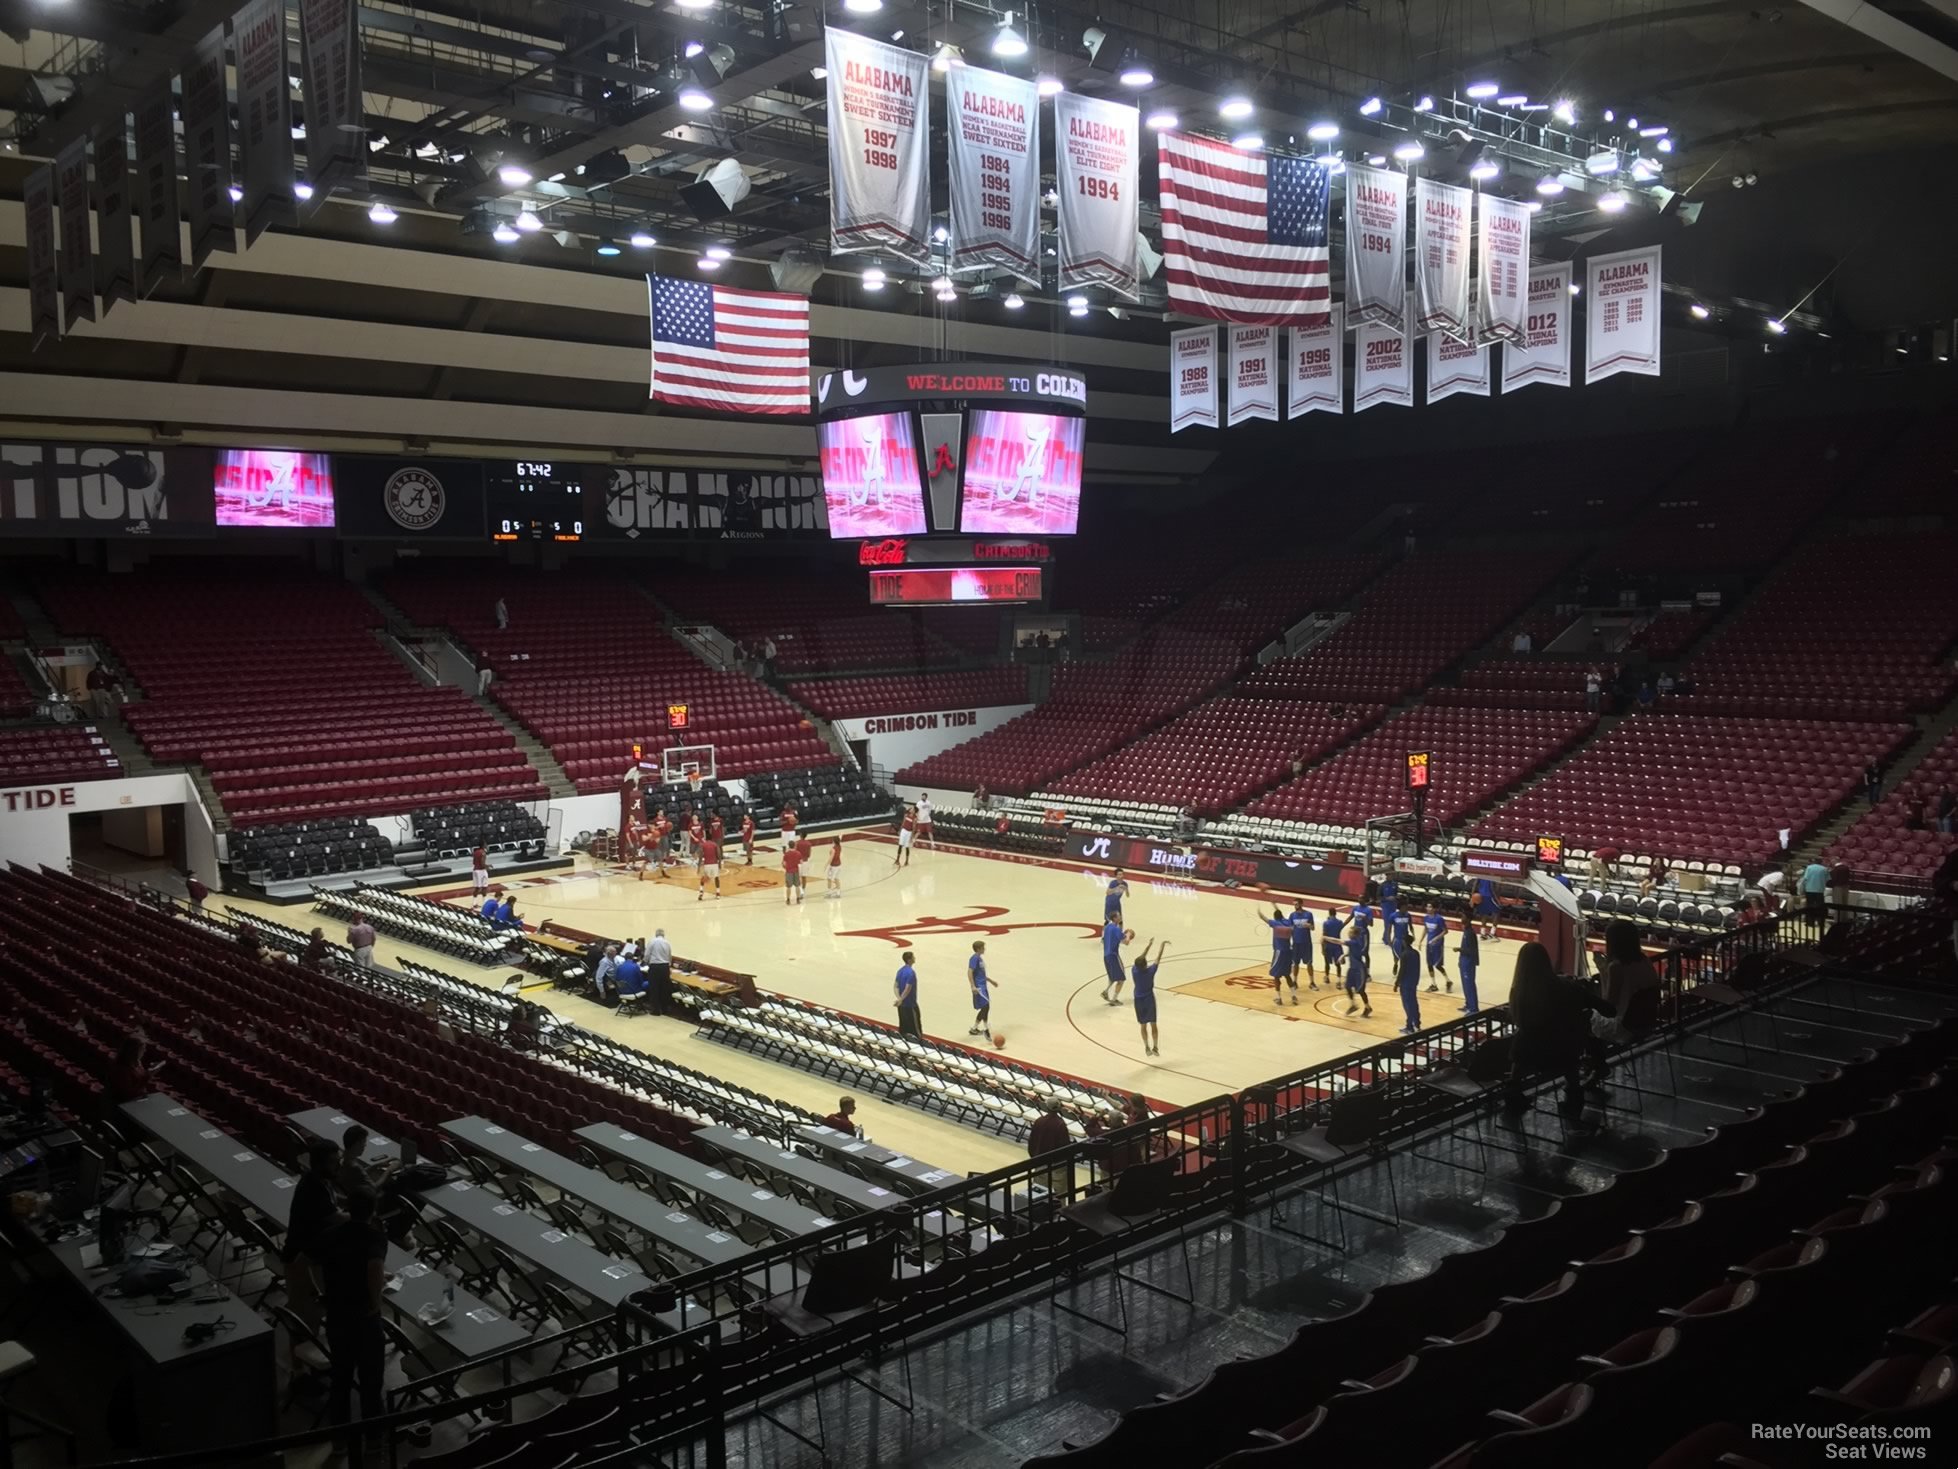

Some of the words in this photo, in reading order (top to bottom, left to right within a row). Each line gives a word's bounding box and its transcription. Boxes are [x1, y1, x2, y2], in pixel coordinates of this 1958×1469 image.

[845, 61, 913, 98] ALABAMA
[844, 93, 865, 106] NCAA
[866, 99, 915, 117] TOURNAMENT
[963, 91, 1025, 124] ALABAMA
[843, 103, 876, 118] SWEET
[878, 110, 915, 129] SIXTEEN
[962, 114, 989, 127] WOMEN'S
[864, 128, 897, 149] 1997
[962, 121, 981, 133] NCAA
[982, 126, 1026, 143] TOURNAMENT
[1070, 117, 1126, 147] ALABAMA
[963, 130, 992, 144] SWEET
[993, 138, 1027, 153] SIXTEEN
[864, 148, 897, 170] 1998
[981, 154, 1011, 174] 1984
[1069, 147, 1085, 156] NCAA
[1087, 150, 1127, 165] TOURNAMENT
[1076, 156, 1098, 168] ELITE
[1100, 161, 1121, 174] EIGHT
[981, 173, 1011, 193] 1994
[1079, 175, 1119, 201] 1994
[981, 192, 1011, 212] 1995
[1356, 184, 1397, 208] ALABAMA
[1426, 199, 1463, 222] ALABAMA
[981, 211, 1011, 231] 1996
[1489, 215, 1521, 235] ALABAMA
[1362, 233, 1392, 254] 1994
[1599, 263, 1649, 282] ALABAMA
[1528, 277, 1560, 293] ABAMA
[1603, 278, 1644, 290] GYMNASTICS
[1611, 284, 1648, 294] CHAMPIONS
[1528, 313, 1557, 332] 012
[1178, 337, 1211, 352] ALABAMA
[1235, 328, 1270, 343] ALABAMA
[1528, 330, 1558, 341] TIONAL
[1366, 338, 1402, 357] 2002
[1440, 350, 1477, 361] CHAMPIONS
[1239, 358, 1267, 374] 1991
[1299, 348, 1331, 366] 1996
[1366, 354, 1402, 365] NATIONAL
[1366, 361, 1402, 371] CHAMPIONS
[1181, 366, 1209, 382] 1988
[1238, 372, 1268, 381] NATIONAL
[1298, 363, 1332, 373] NATIONAL
[1298, 370, 1333, 380] CHAMPIONS
[907, 374, 1005, 392] WELCOME
[1009, 377, 1030, 392] TO
[1180, 380, 1209, 389] NATIONAL
[1180, 386, 1209, 396] CHAMPIONS
[1238, 379, 1268, 389] CHAMPIONS
[516, 462, 552, 477] 67:42
[502, 519, 511, 533] 0
[574, 521, 582, 534] 0
[729, 529, 765, 539] REGIONS
[672, 713, 685, 726] 30
[865, 713, 938, 734] CRIMSON
[942, 711, 977, 728] TIDE
[1411, 766, 1428, 786] 30
[3, 787, 76, 812] TIDE
[1224, 858, 1259, 878] THE
